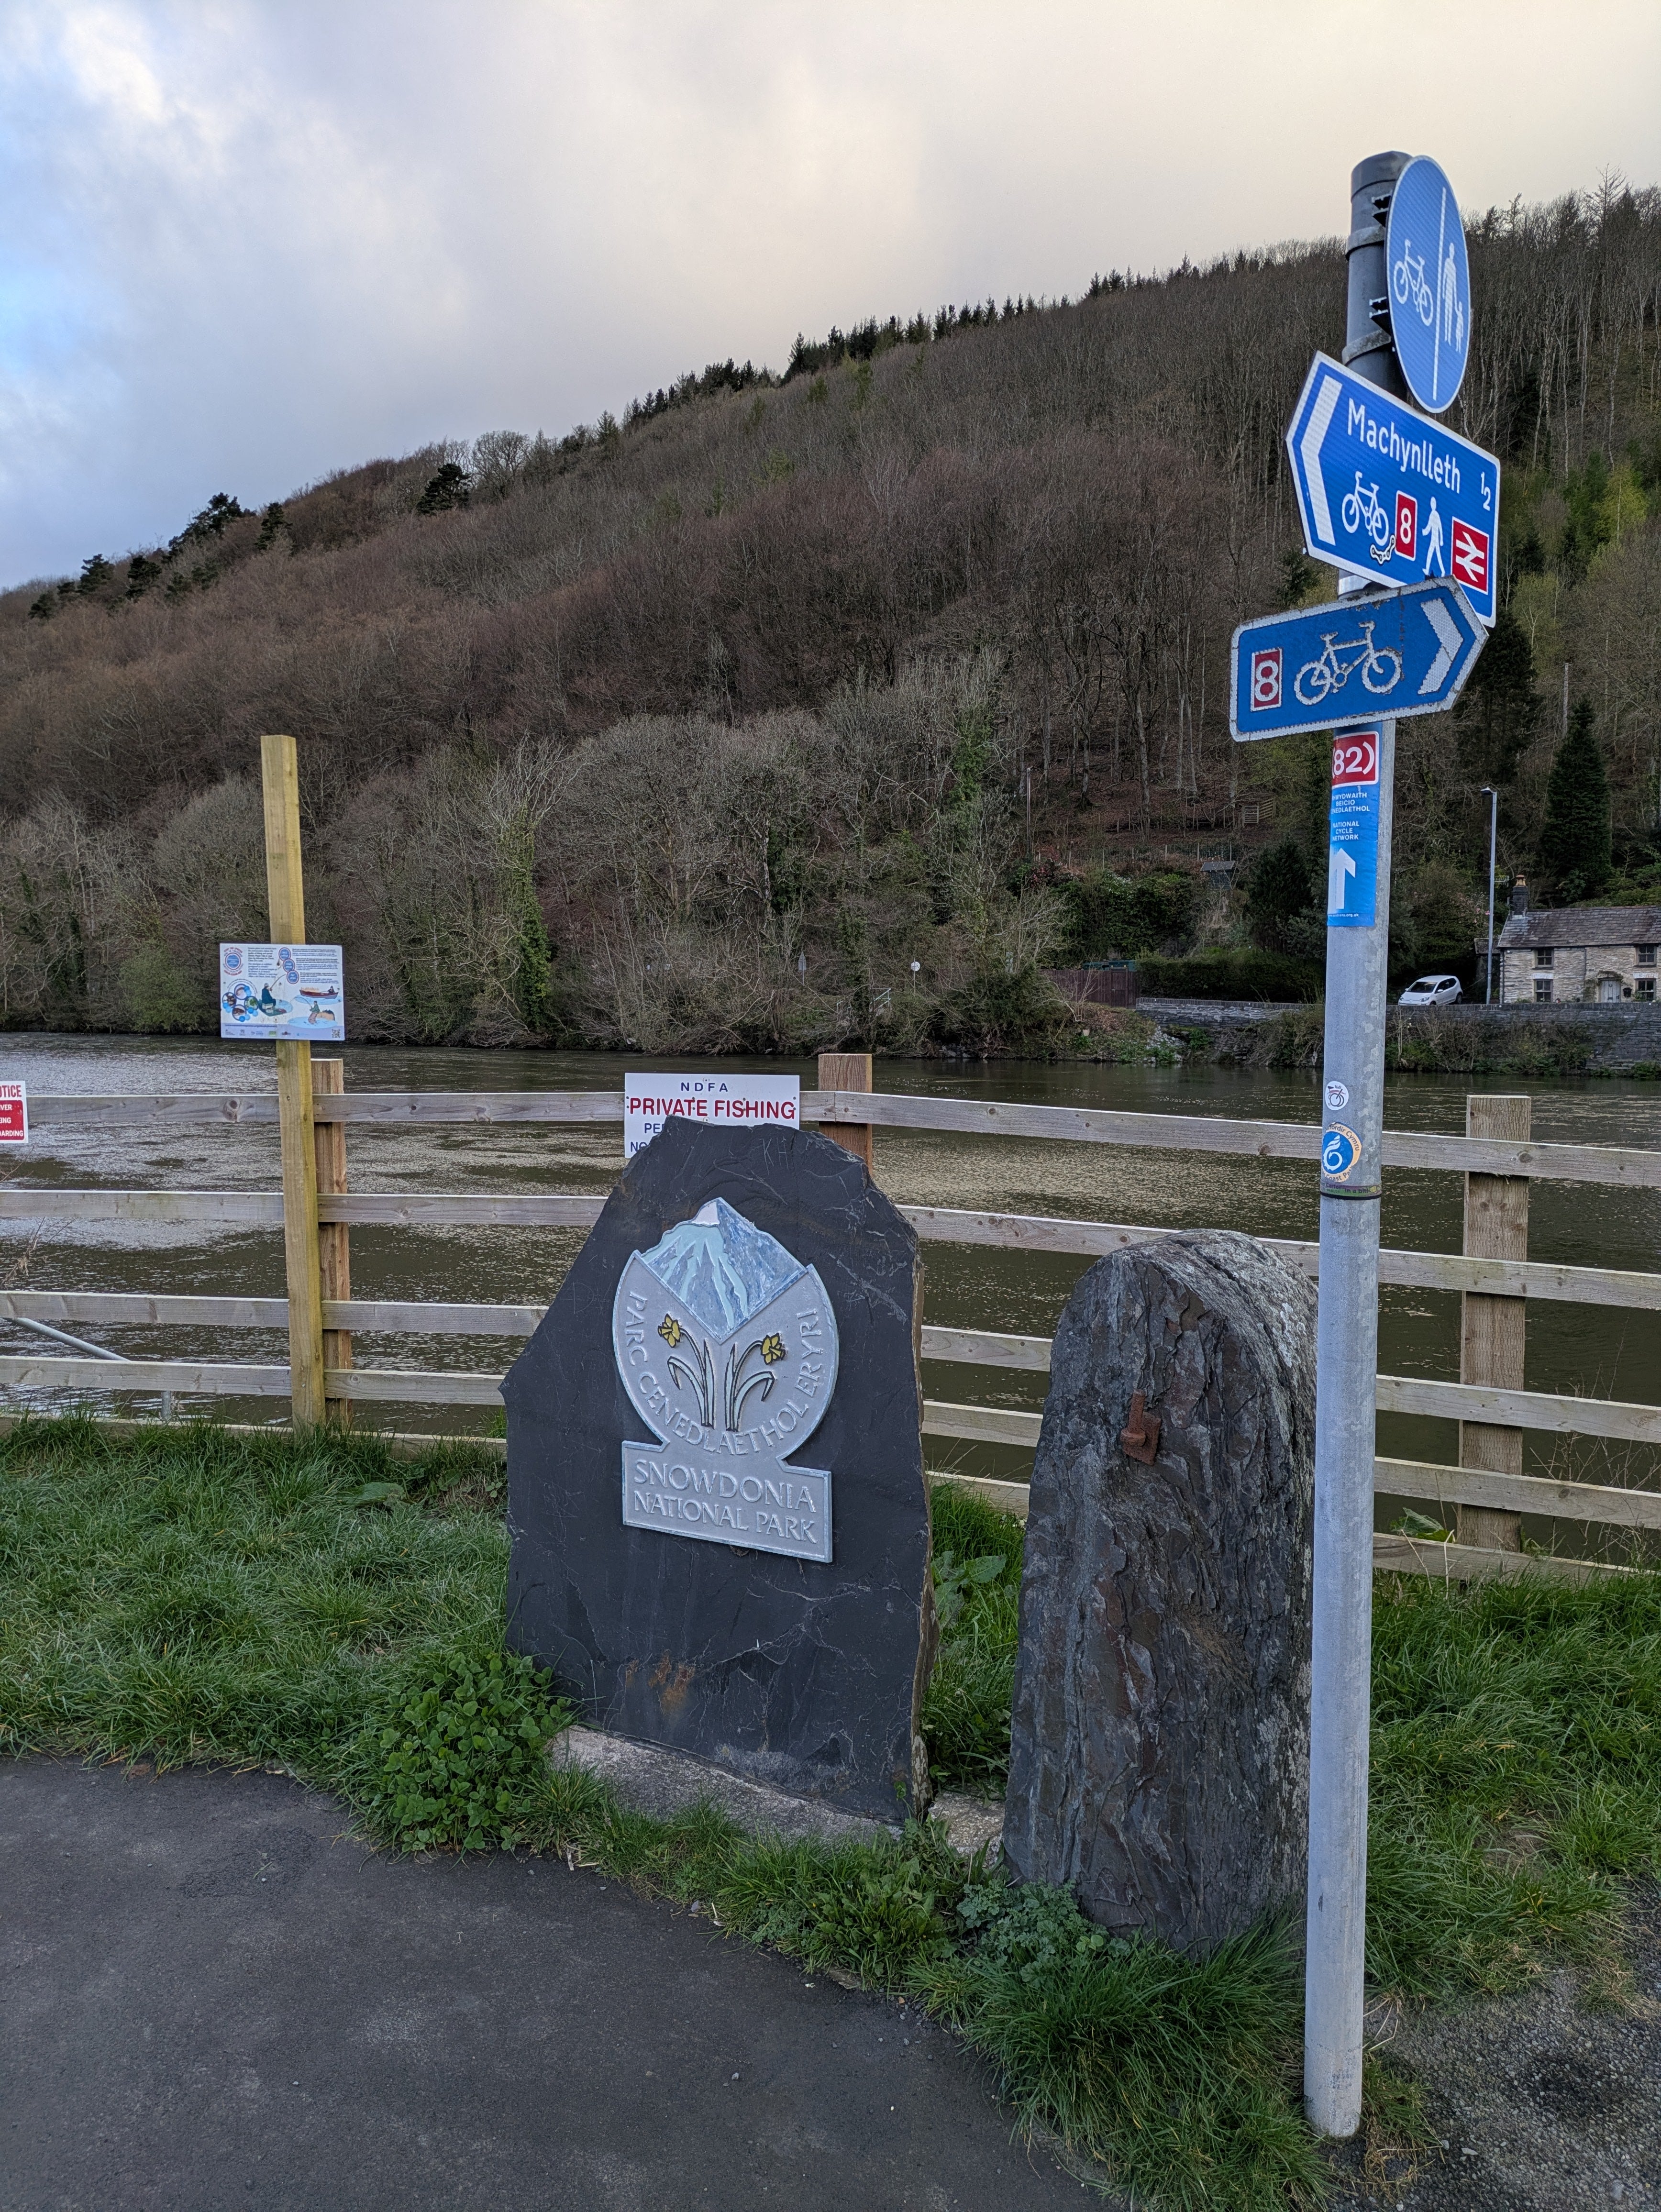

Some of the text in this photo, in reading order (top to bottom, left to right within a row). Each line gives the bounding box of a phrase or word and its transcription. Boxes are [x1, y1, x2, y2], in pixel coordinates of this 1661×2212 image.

[1347, 398, 1461, 494] Machynlleth
[1400, 508, 1412, 544] 8
[1254, 660, 1279, 702] 8
[630, 1097, 796, 1120] PRIVATE FISHING
[1346, 1131, 1360, 1151] Cymru
[626, 1291, 648, 1367] PARC
[637, 1372, 810, 1456] CENEDLAETHOL
[794, 1308, 823, 1397] ERYRI
[634, 1459, 816, 1514] SNOWDONIA
[634, 1490, 819, 1544] NATIONAL PARK
